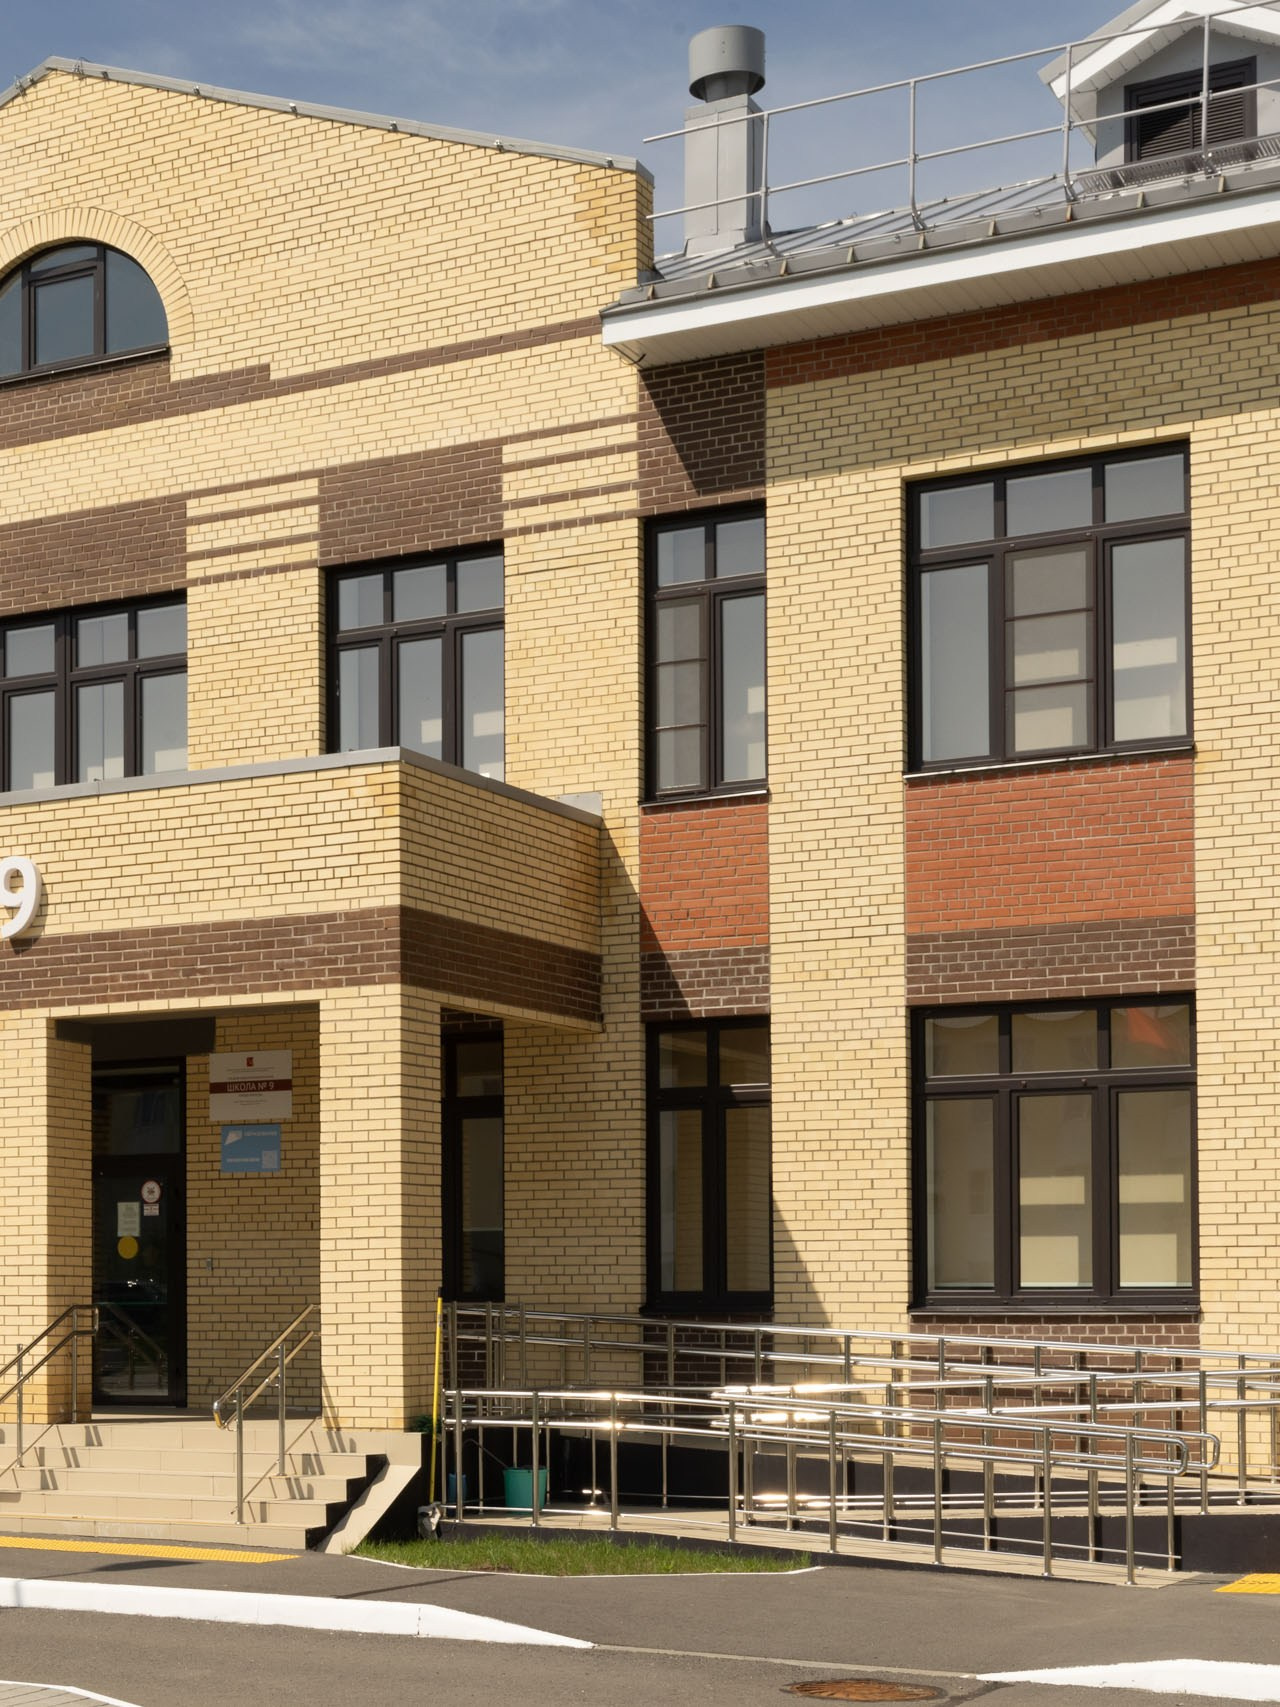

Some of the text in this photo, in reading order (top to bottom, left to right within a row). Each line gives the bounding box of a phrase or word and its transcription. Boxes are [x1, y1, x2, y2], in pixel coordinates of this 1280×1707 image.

[227, 1081, 274, 1091] ШКОЛА № 9
